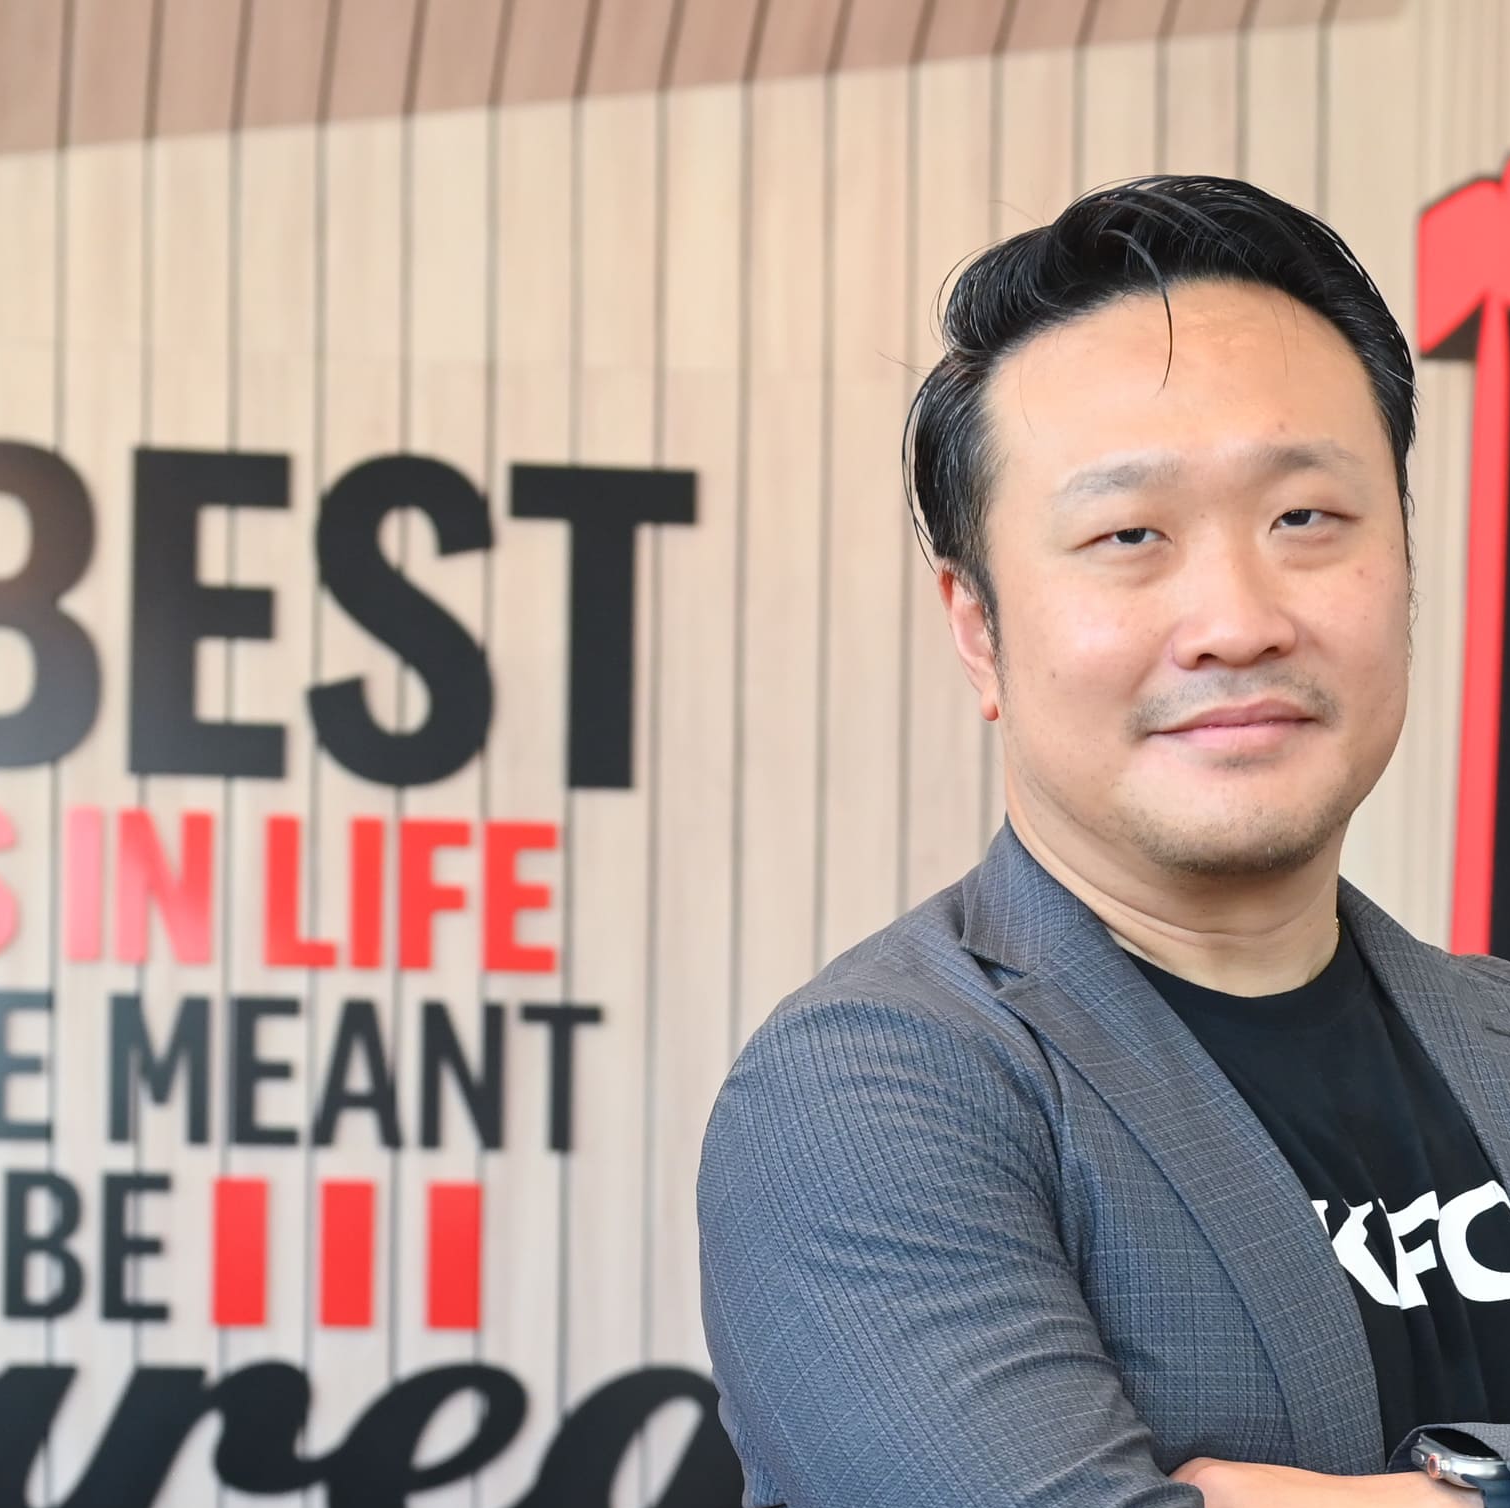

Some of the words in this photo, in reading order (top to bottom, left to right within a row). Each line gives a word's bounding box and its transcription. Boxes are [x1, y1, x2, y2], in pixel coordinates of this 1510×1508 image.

[64, 806, 215, 965] IN
[263, 814, 561, 974] LIFE
[108, 994, 604, 1154] MEANT
[2, 1171, 173, 1325] BE
